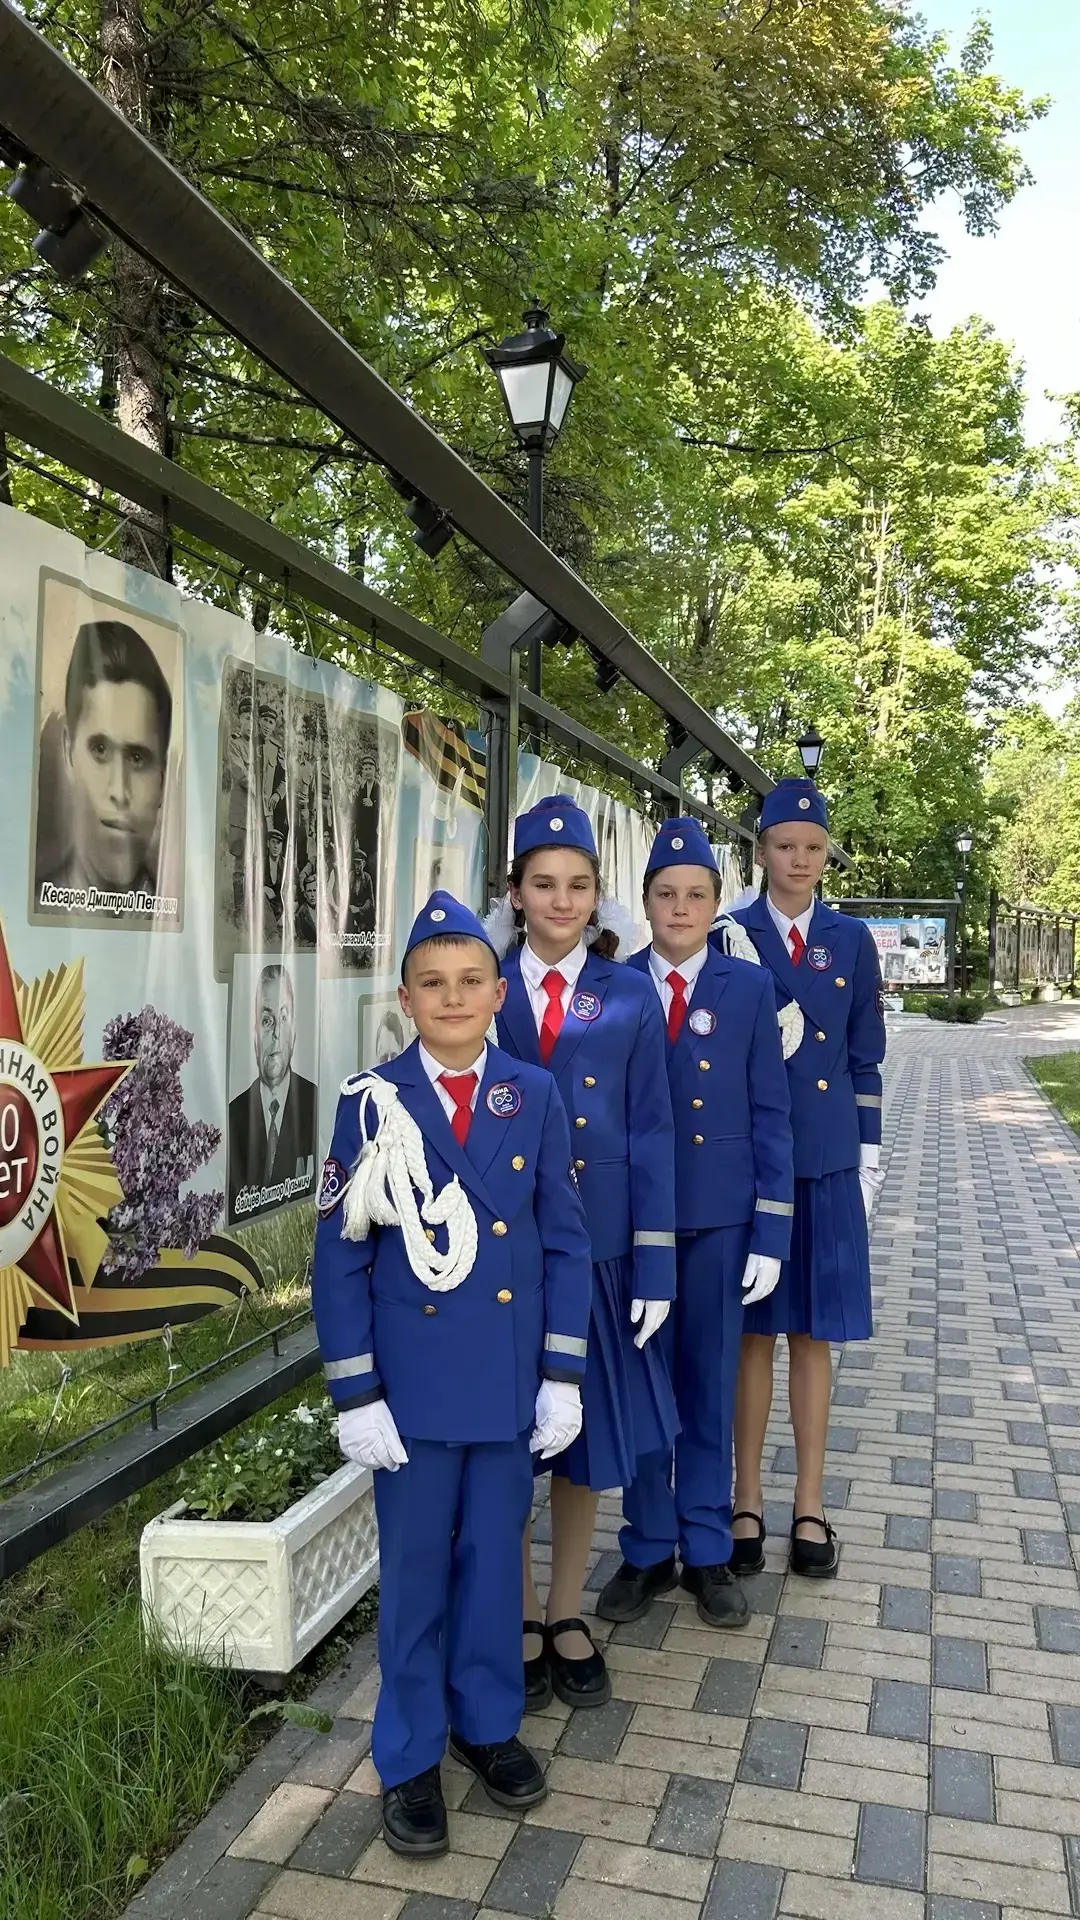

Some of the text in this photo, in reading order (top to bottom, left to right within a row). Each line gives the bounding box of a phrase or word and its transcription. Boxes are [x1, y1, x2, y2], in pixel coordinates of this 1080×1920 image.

[40, 883, 86, 911] Кесарев
[87, 887, 134, 914] Дмитрий
[876, 939, 898, 948] БЕДА
[0, 1103, 20, 1152] 0
[0, 1156, 29, 1200] ет
[22, 1110, 60, 1231] ВОЙНА
